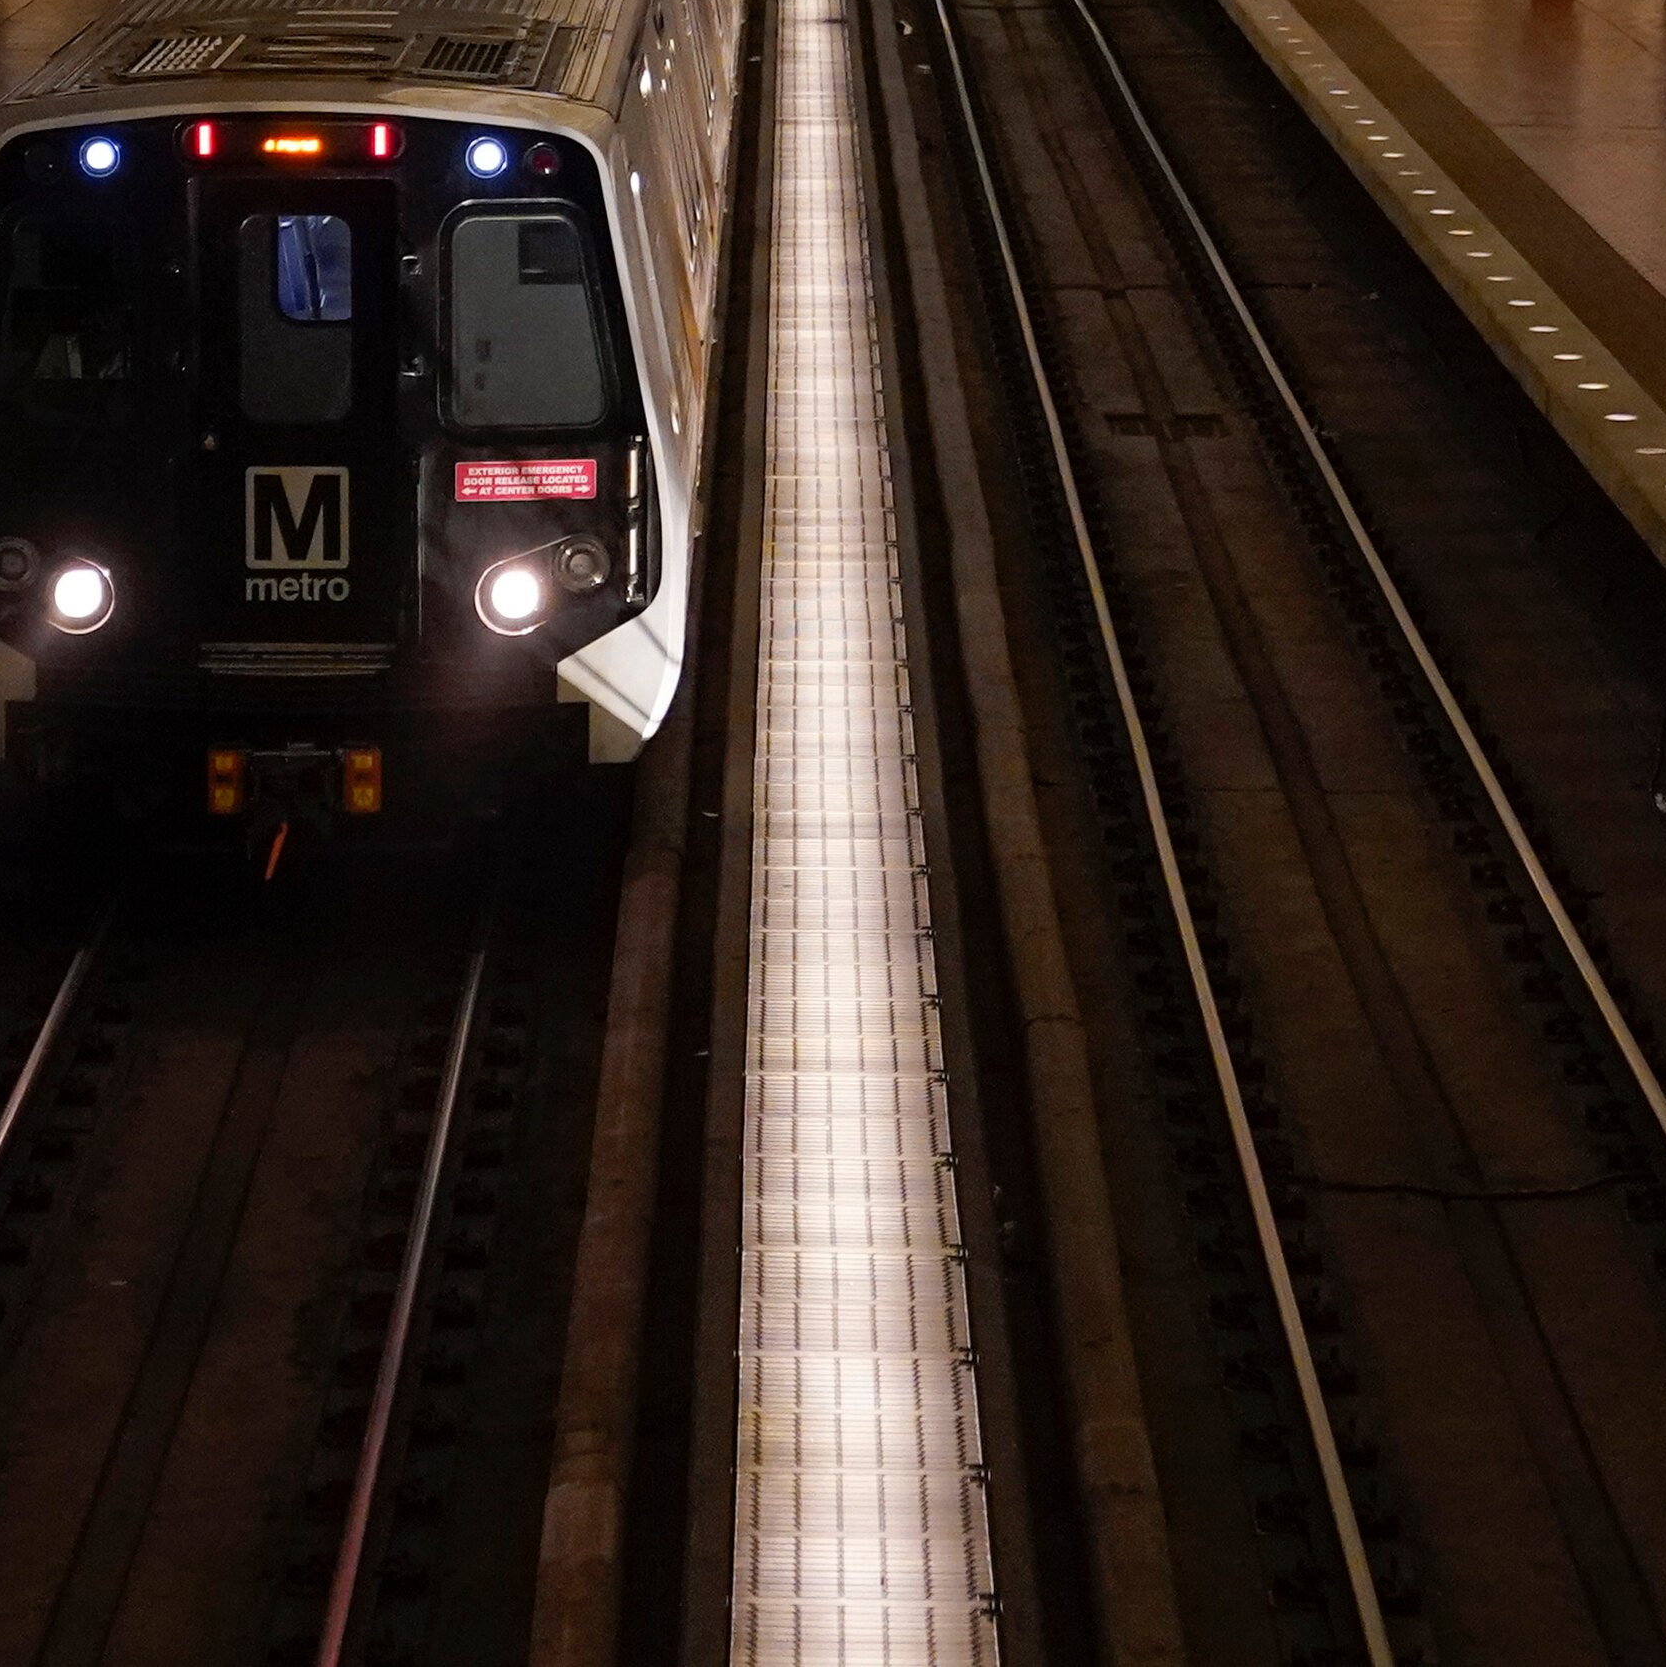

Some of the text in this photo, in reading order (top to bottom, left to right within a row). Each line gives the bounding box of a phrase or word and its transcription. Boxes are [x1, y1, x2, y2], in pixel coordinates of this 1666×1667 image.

[468, 464, 584, 476] EXTERIOR EMERGENCY
[463, 474, 589, 486] DOOR RELEASE LOCATED
[478, 485, 573, 496] AT CENTER DOORS
[254, 474, 341, 561] M
[245, 572, 351, 602] metro
